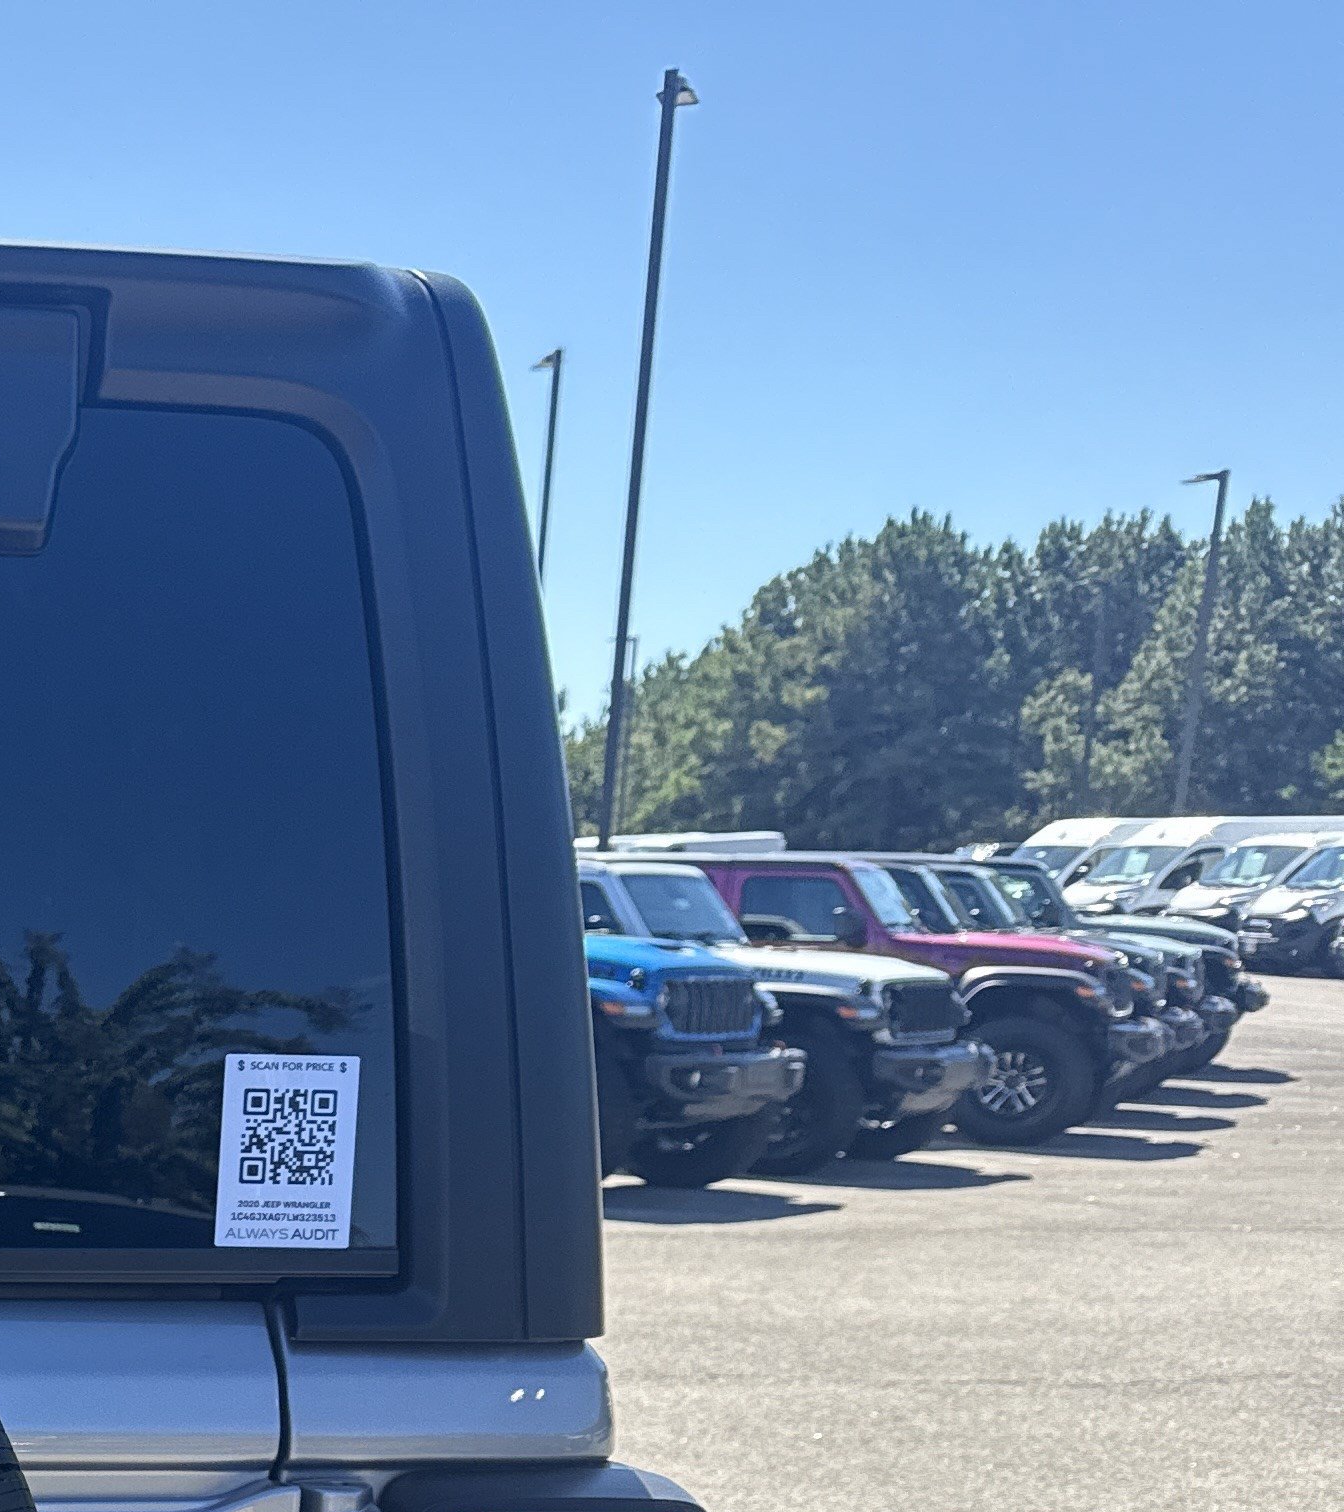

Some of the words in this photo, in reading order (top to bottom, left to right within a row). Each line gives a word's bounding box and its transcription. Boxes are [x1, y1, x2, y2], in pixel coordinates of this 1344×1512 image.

[250, 1061, 279, 1071] SCAN
[282, 1062, 303, 1071] FOR
[306, 1062, 334, 1072] PRICE
[261, 1201, 282, 1209] JEEP
[283, 1201, 331, 1209] WRANGLER
[225, 1227, 289, 1240] ALWAYS
[290, 1228, 340, 1241] AUDIT
